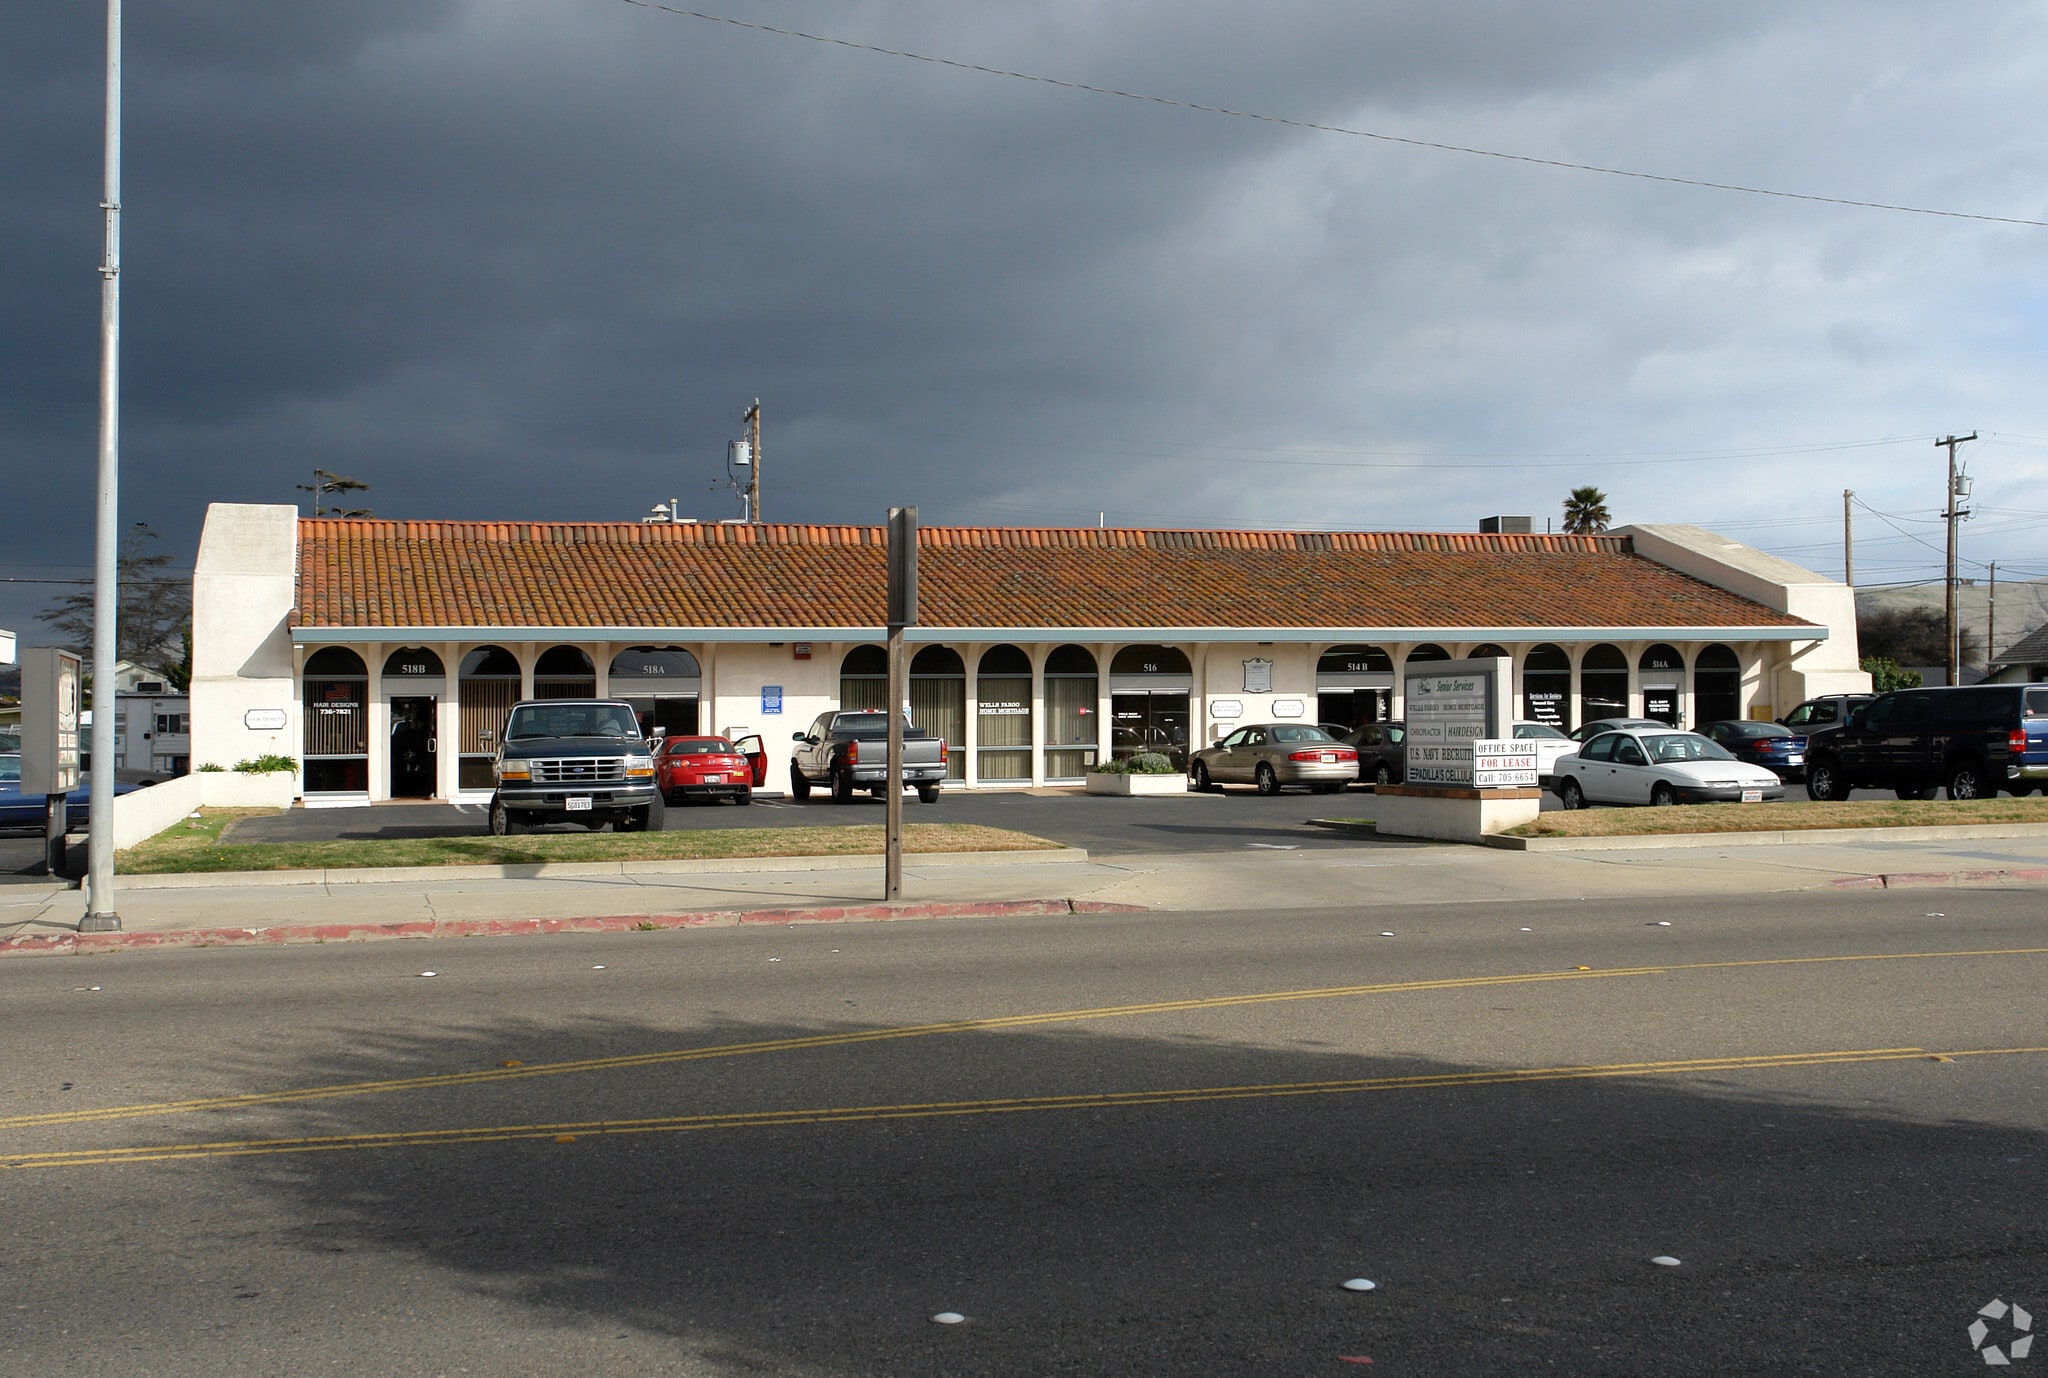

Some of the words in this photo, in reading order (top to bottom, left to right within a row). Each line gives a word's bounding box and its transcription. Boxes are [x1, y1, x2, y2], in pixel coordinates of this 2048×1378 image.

[402, 664, 426, 673] 518B
[1143, 663, 1157, 672] 516
[1347, 663, 1360, 671] 514
[1652, 660, 1669, 668] 514A
[643, 665, 664, 674] 518A
[1436, 680, 1452, 692] Senior
[1453, 679, 1474, 692] Services
[1478, 744, 1506, 753] OFFICE
[1510, 744, 1534, 752] SPACE
[1423, 748, 1439, 760] NAVY
[1482, 759, 1498, 768] FOR
[1504, 758, 1532, 768] LEASE
[1416, 769, 1445, 780] PADILLA'S
[1446, 770, 1473, 782] CELLULA
[1478, 774, 1496, 782] Call:
[1498, 773, 1534, 782] 705-6654
